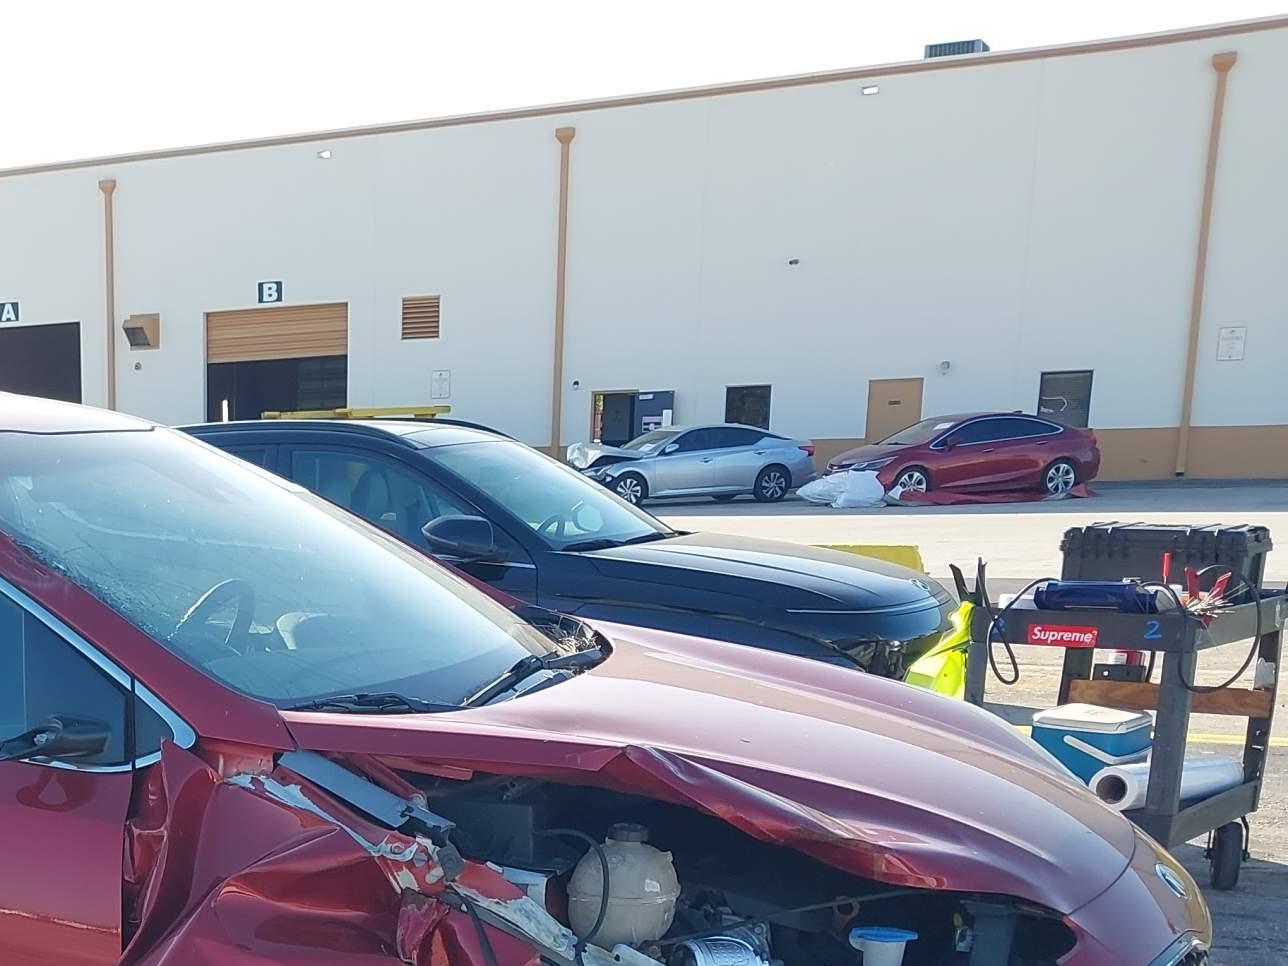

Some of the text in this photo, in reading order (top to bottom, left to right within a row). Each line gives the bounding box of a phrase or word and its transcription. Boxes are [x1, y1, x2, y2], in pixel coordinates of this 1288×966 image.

[262, 282, 278, 302] B
[1, 303, 17, 322] A
[1031, 626, 1093, 644] Supreme
[1143, 620, 1162, 640] 2
